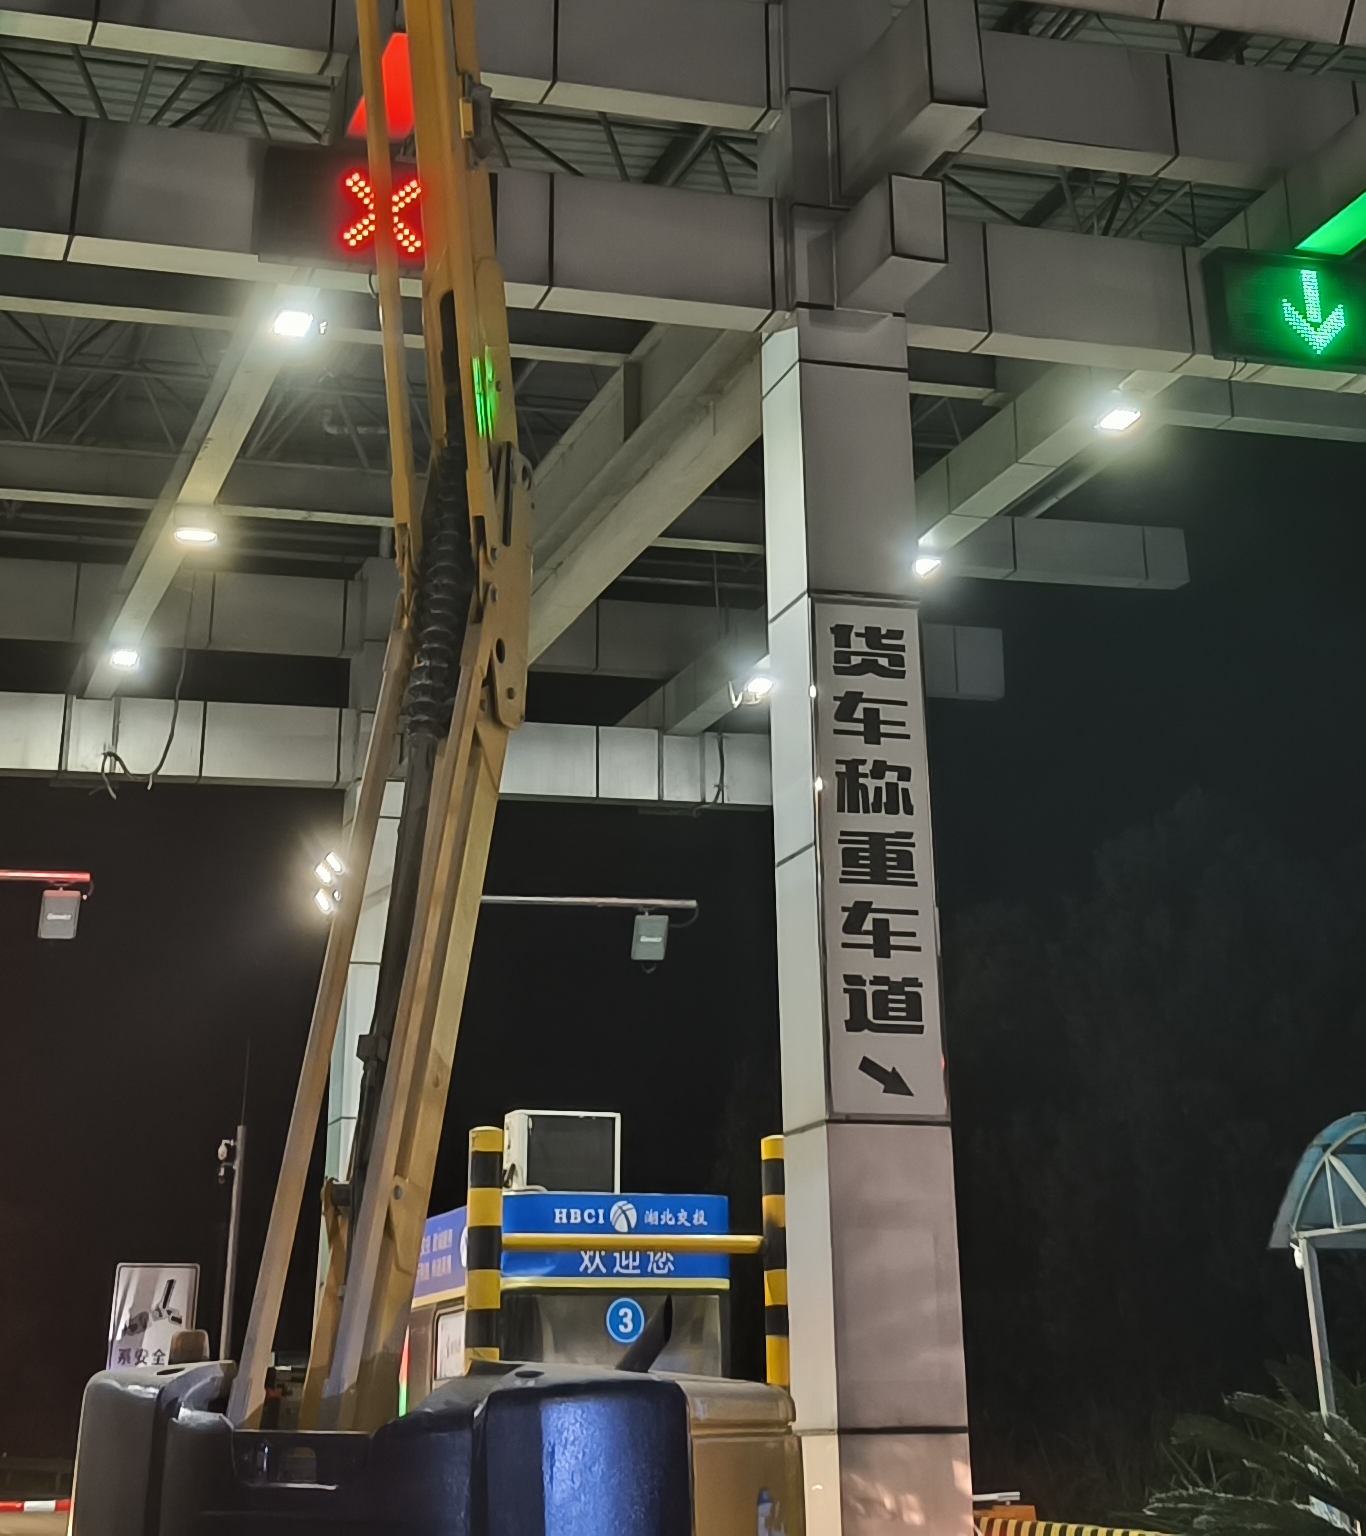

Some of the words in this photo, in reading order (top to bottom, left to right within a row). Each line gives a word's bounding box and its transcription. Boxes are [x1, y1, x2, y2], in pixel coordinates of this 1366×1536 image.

[830, 623, 925, 1035] 货车称重车道
[554, 1208, 605, 1224] HBCI
[644, 1208, 708, 1227] 湖北交投
[578, 1250, 675, 1275] 欢迎您
[618, 1307, 634, 1334] 3
